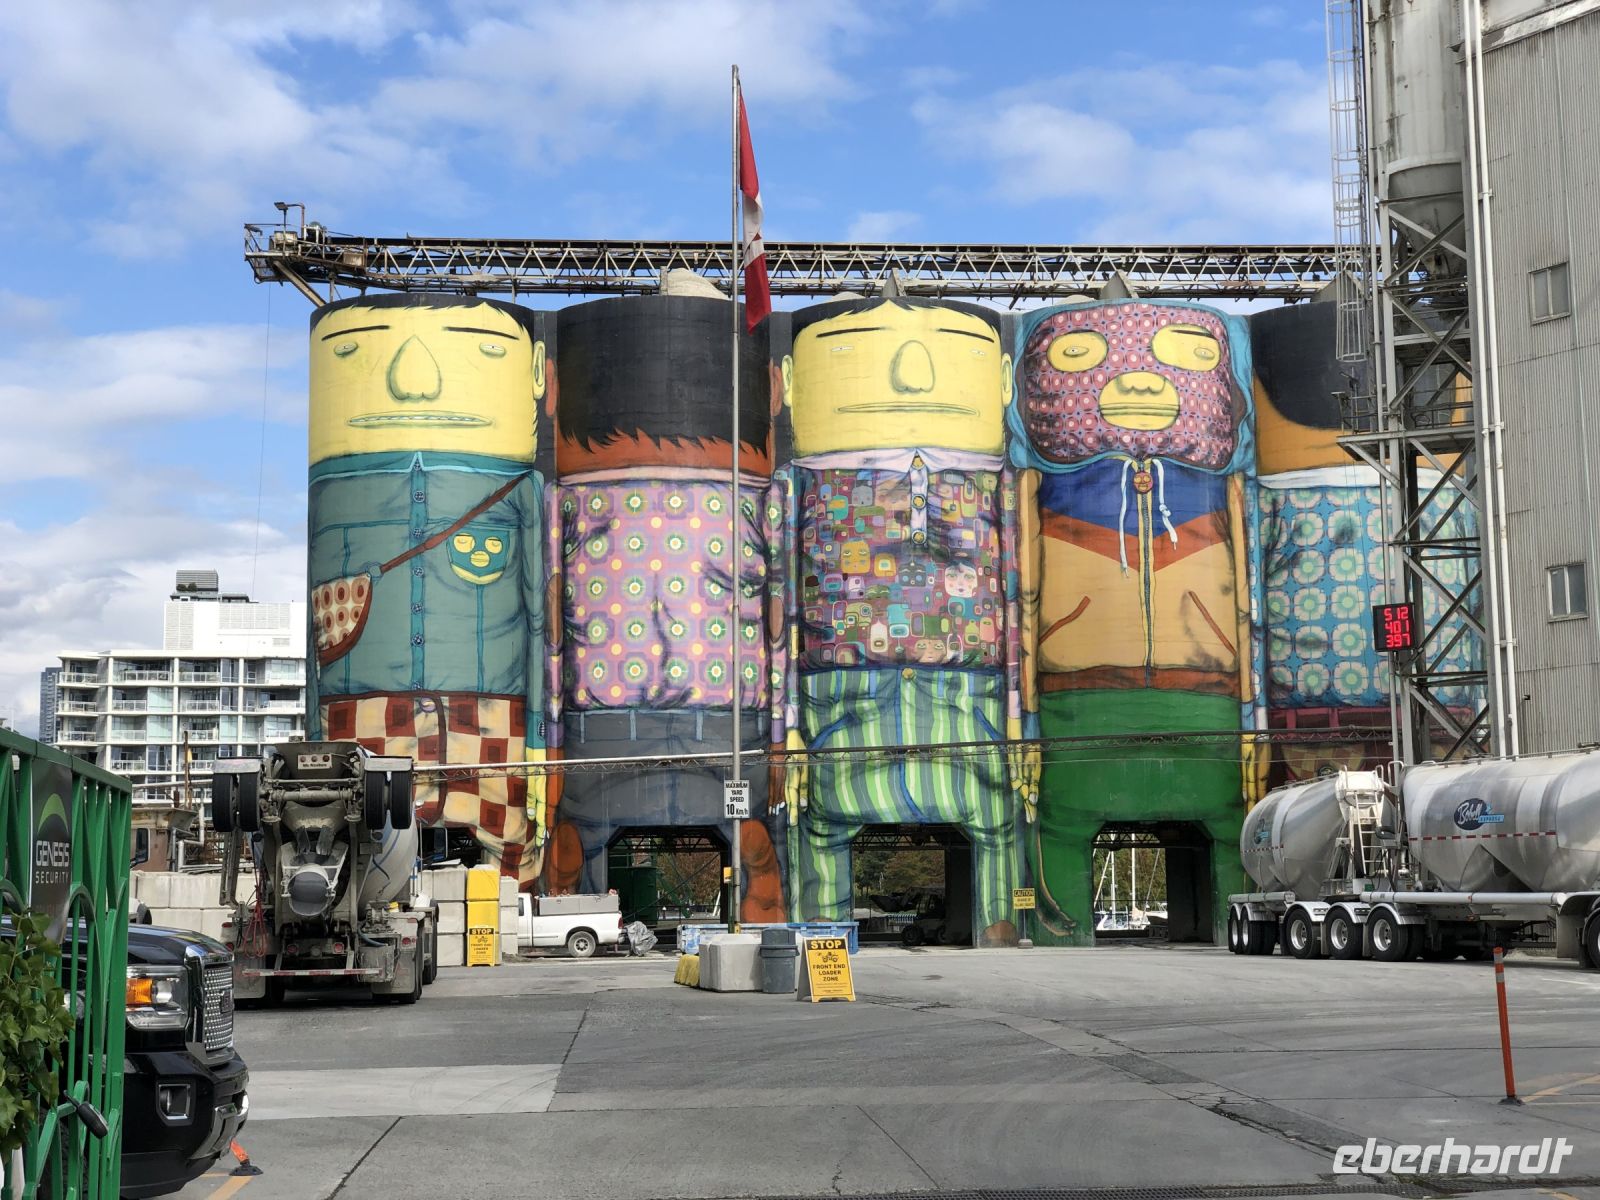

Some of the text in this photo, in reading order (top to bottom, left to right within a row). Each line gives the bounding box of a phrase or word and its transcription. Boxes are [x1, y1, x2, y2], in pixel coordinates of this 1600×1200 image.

[1384, 606, 1409, 621] 512
[1385, 620, 1410, 634] 401
[1385, 633, 1411, 648] 397
[726, 803, 735, 815] 10
[35, 840, 70, 867] GENESIS
[35, 871, 70, 884] SECURITY
[810, 940, 842, 949] STOP
